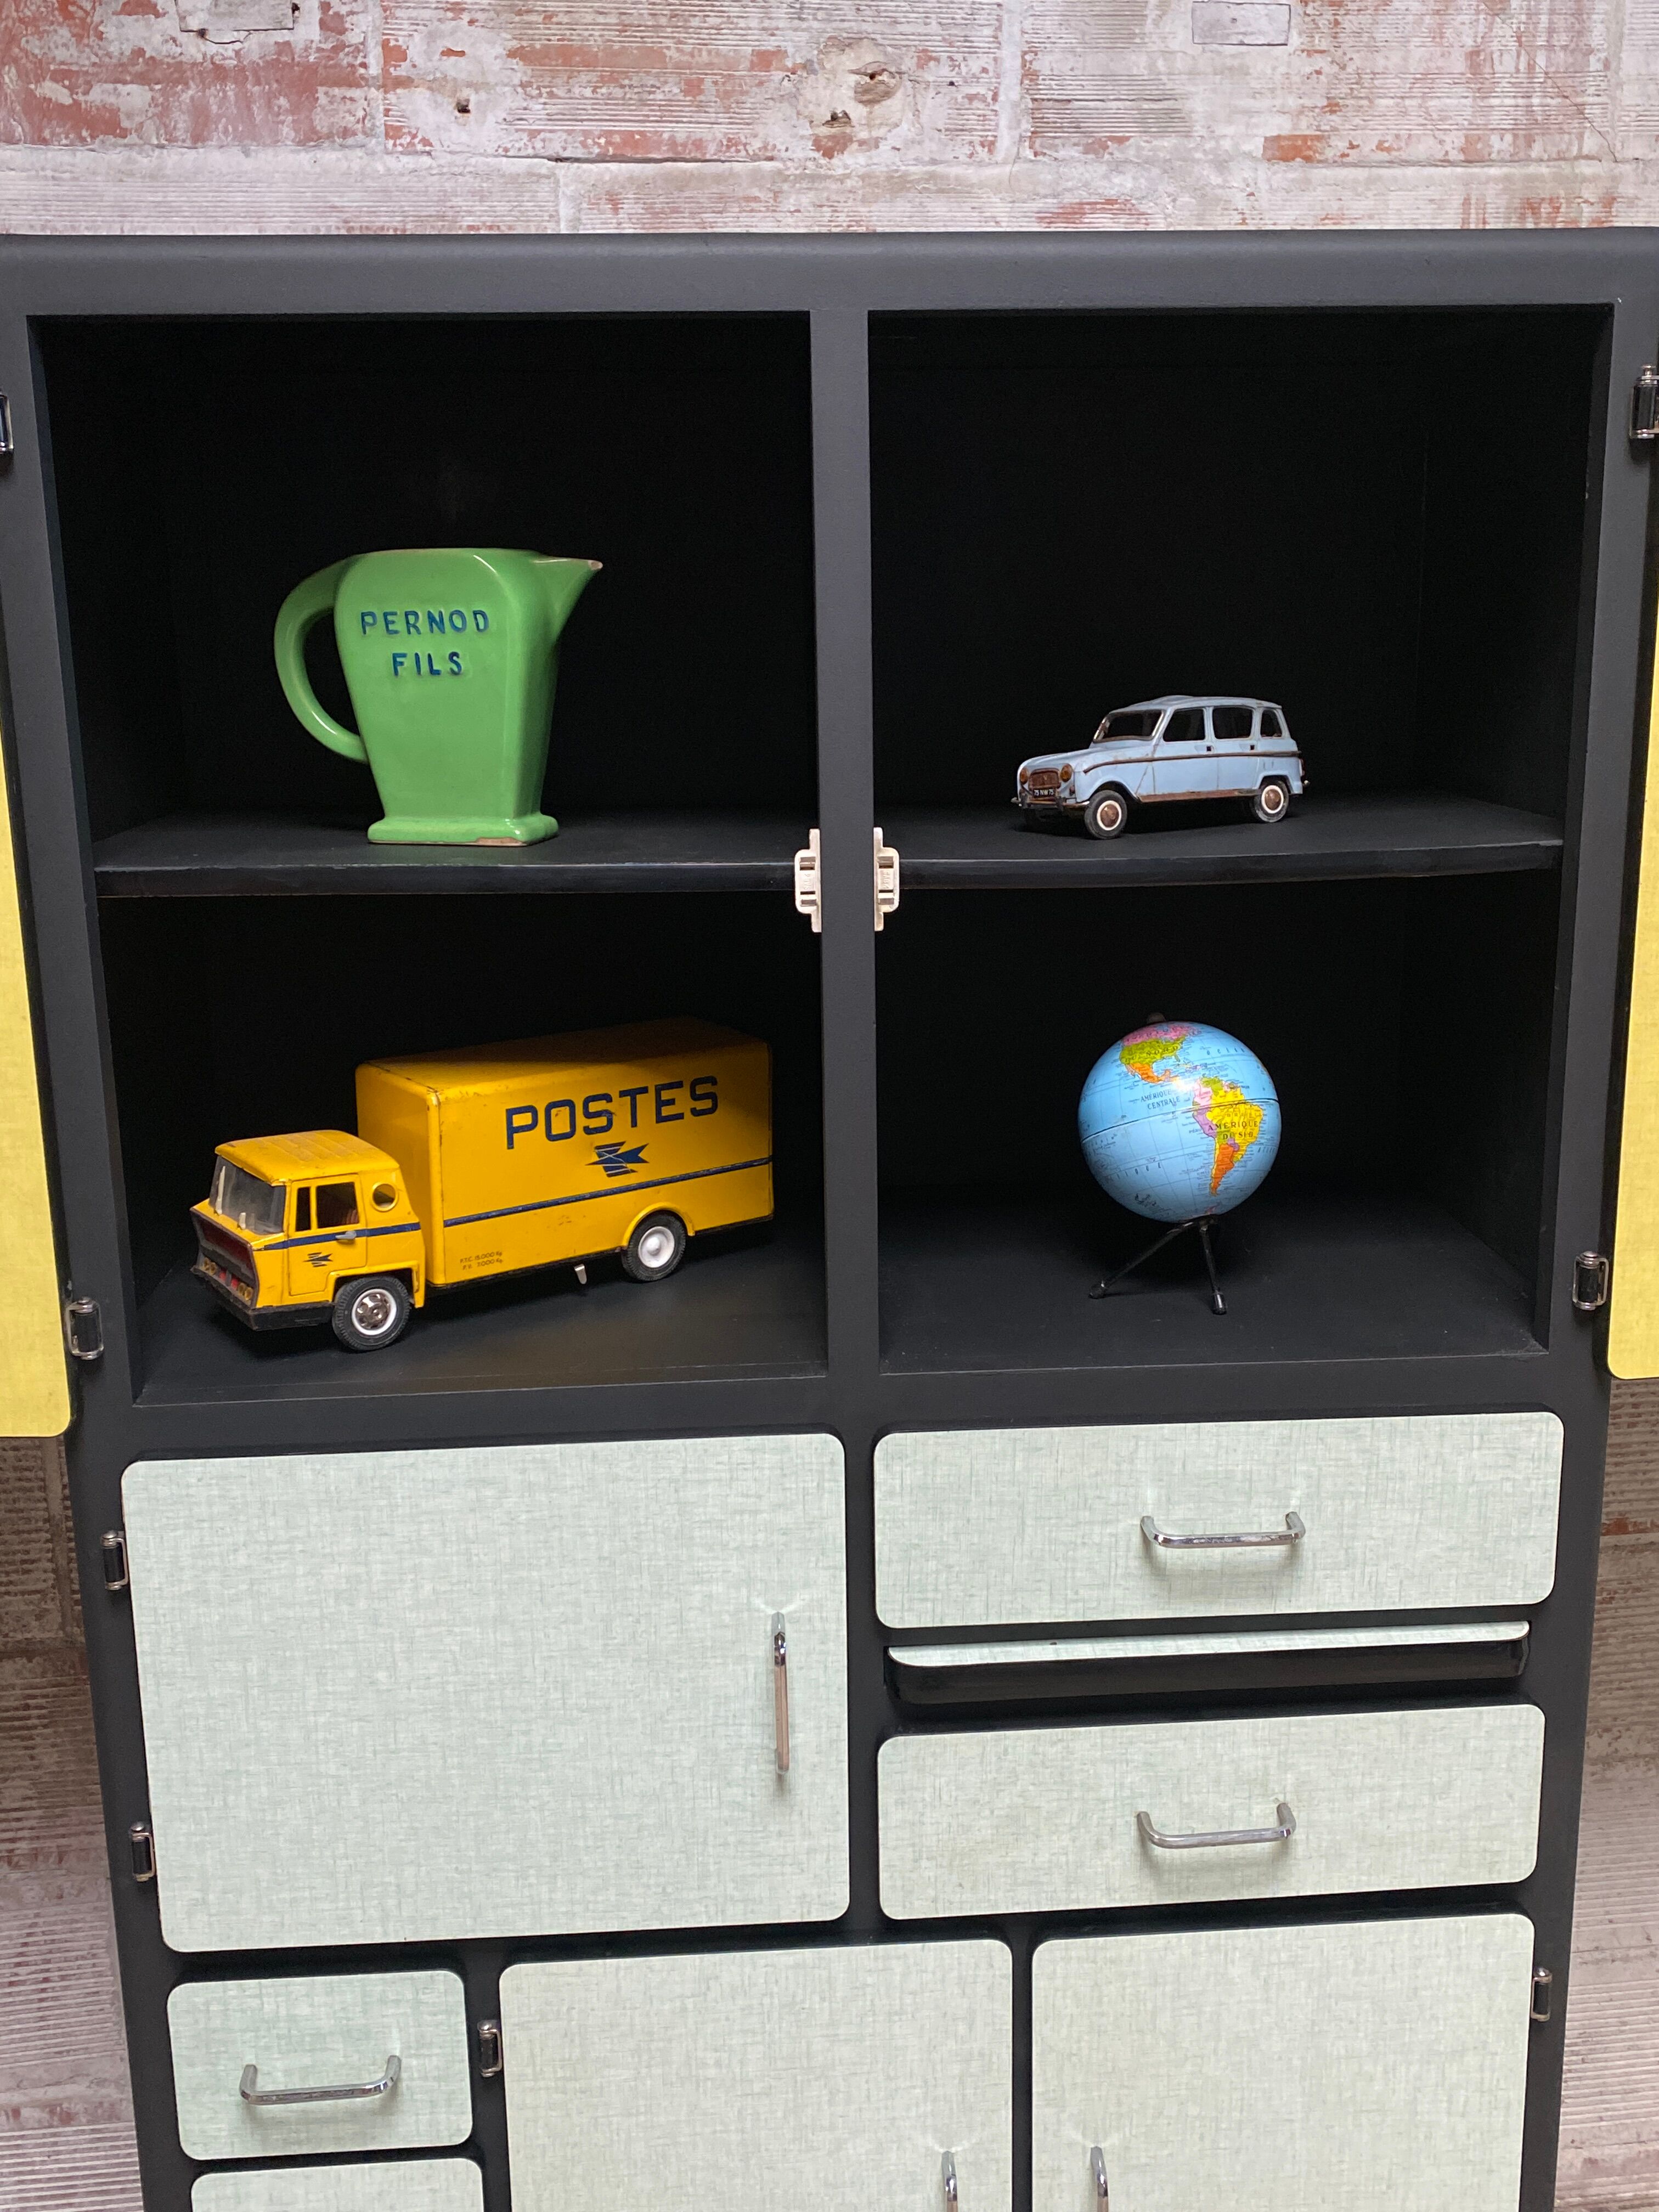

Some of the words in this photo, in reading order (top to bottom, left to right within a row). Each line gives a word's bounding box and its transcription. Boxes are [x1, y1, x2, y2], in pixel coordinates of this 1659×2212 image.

[360, 609, 489, 635] PERNOD
[392, 651, 463, 676] FILS
[505, 1076, 719, 1150] POSTES
[1148, 1096, 1180, 1110] CENTRALE
